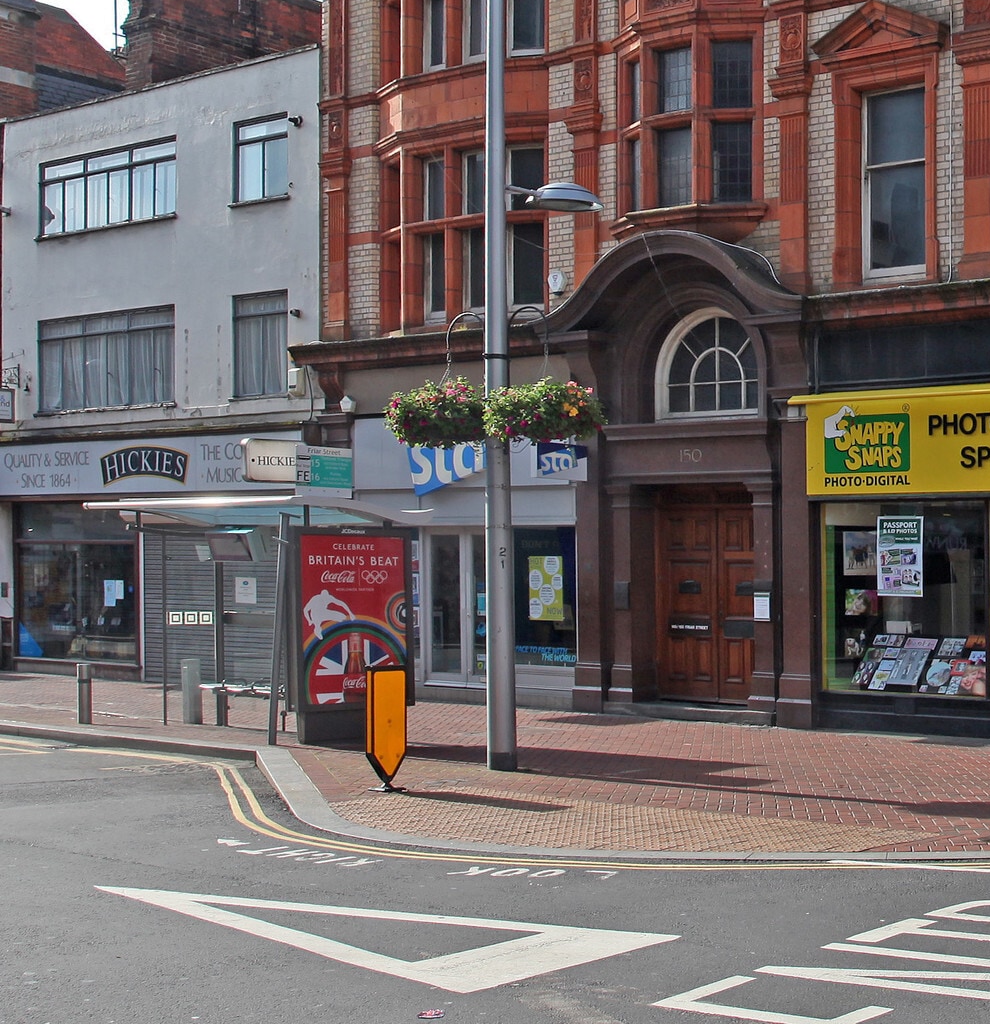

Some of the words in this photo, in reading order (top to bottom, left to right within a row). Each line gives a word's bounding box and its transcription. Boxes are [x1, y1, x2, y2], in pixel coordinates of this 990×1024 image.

[833, 418, 905, 452] SNAPPY
[200, 444, 220, 461] THE
[680, 448, 702, 463] 150
[844, 446, 903, 471] SNAPS
[4, 453, 42, 472] QUALITY
[43, 454, 51, 467] &
[55, 451, 90, 467] SERVICE
[104, 450, 185, 483] HICKIES
[21, 473, 45, 489] SINCE
[50, 474, 71, 488] 1864
[883, 521, 917, 529] PASSPORT
[332, 543, 375, 551] CELEBRATE
[309, 555, 364, 566] BRITAIN'S
[370, 556, 399, 566] BEAT
[541, 654, 553, 662] THE
[554, 654, 577, 663] WORLD
[446, 866, 619, 881] LOOK
